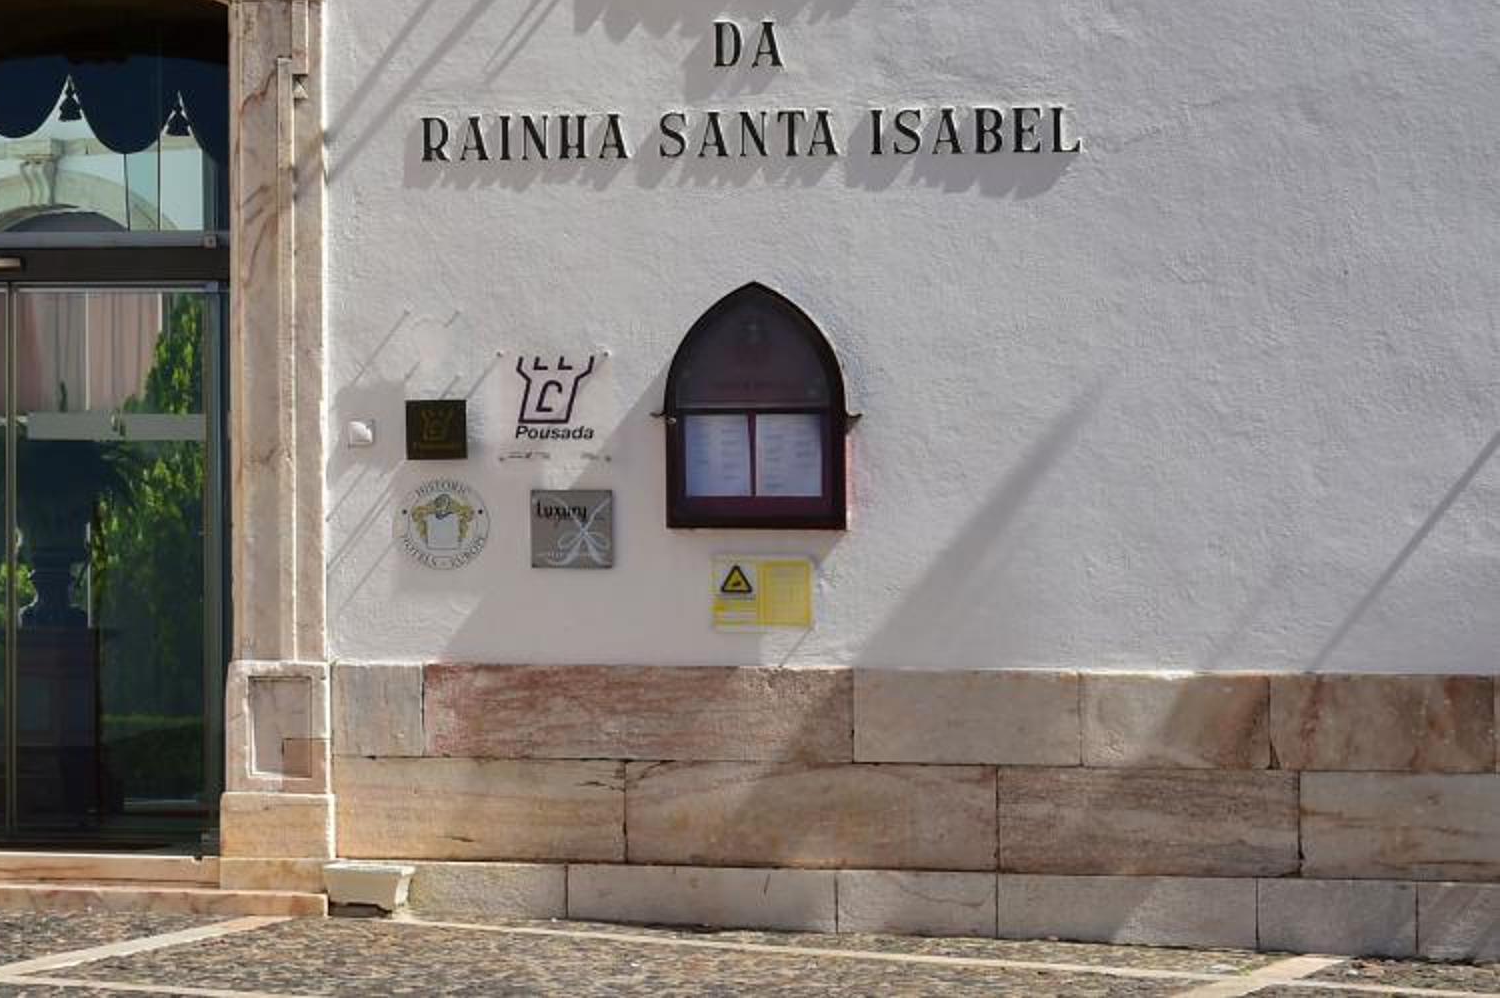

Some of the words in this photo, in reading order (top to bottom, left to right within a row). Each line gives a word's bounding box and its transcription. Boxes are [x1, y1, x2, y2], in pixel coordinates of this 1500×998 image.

[714, 22, 783, 68] DA
[421, 114, 630, 163] RAINHA
[659, 110, 839, 159] SANTA
[870, 107, 1081, 156] ISABEL
[515, 425, 595, 440] Pousada
